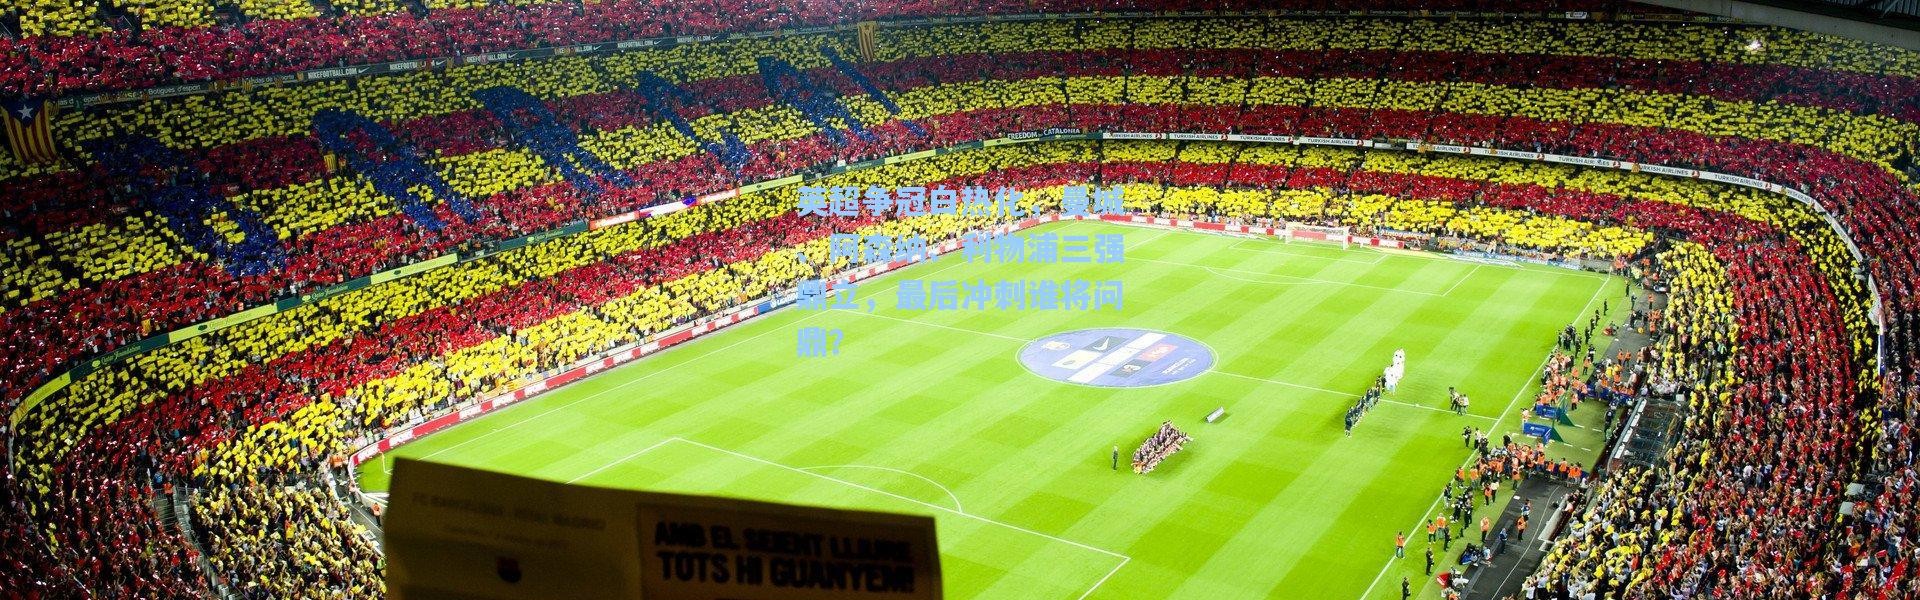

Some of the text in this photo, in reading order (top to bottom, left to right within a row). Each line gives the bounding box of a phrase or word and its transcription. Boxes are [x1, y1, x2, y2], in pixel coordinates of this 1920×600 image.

[307, 66, 358, 79] NIKEFOOTBALL.COM
[1007, 131, 1038, 140] FREEDOM
[1043, 128, 1081, 136] CATALONIA
[1509, 151, 1534, 159] AIRLINES
[1558, 156, 1583, 164] TURKISH
[1661, 167, 1689, 176] AIRLINES
[1714, 174, 1763, 188] TURKISH AIRLINES
[654, 521, 910, 562] AMB EL SEIENT LLIURE
[656, 551, 731, 584] TOTS
[736, 555, 763, 585] HI
